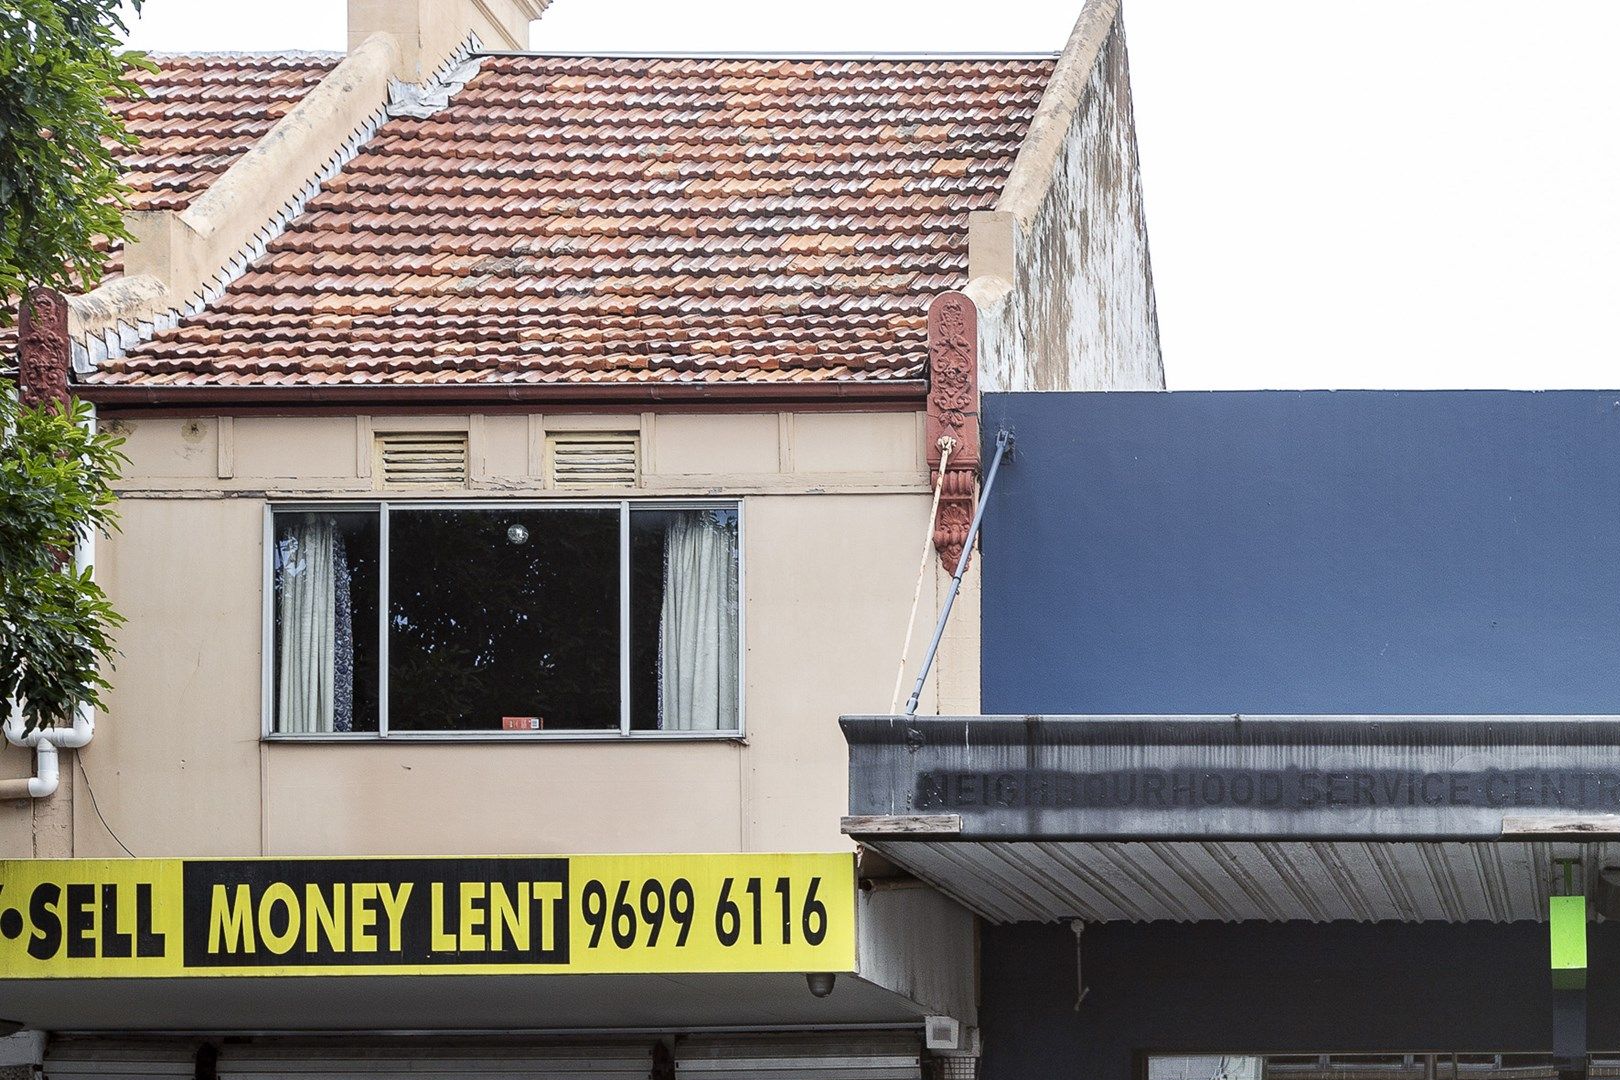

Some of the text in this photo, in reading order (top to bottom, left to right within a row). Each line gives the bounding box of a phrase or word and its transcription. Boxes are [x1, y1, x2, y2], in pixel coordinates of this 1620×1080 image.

[921, 772, 1283, 805] NEIGHBOURHOOD
[1299, 772, 1470, 805] SERVICE
[27, 877, 828, 960] SELL MONEY LENT 9699 6116
